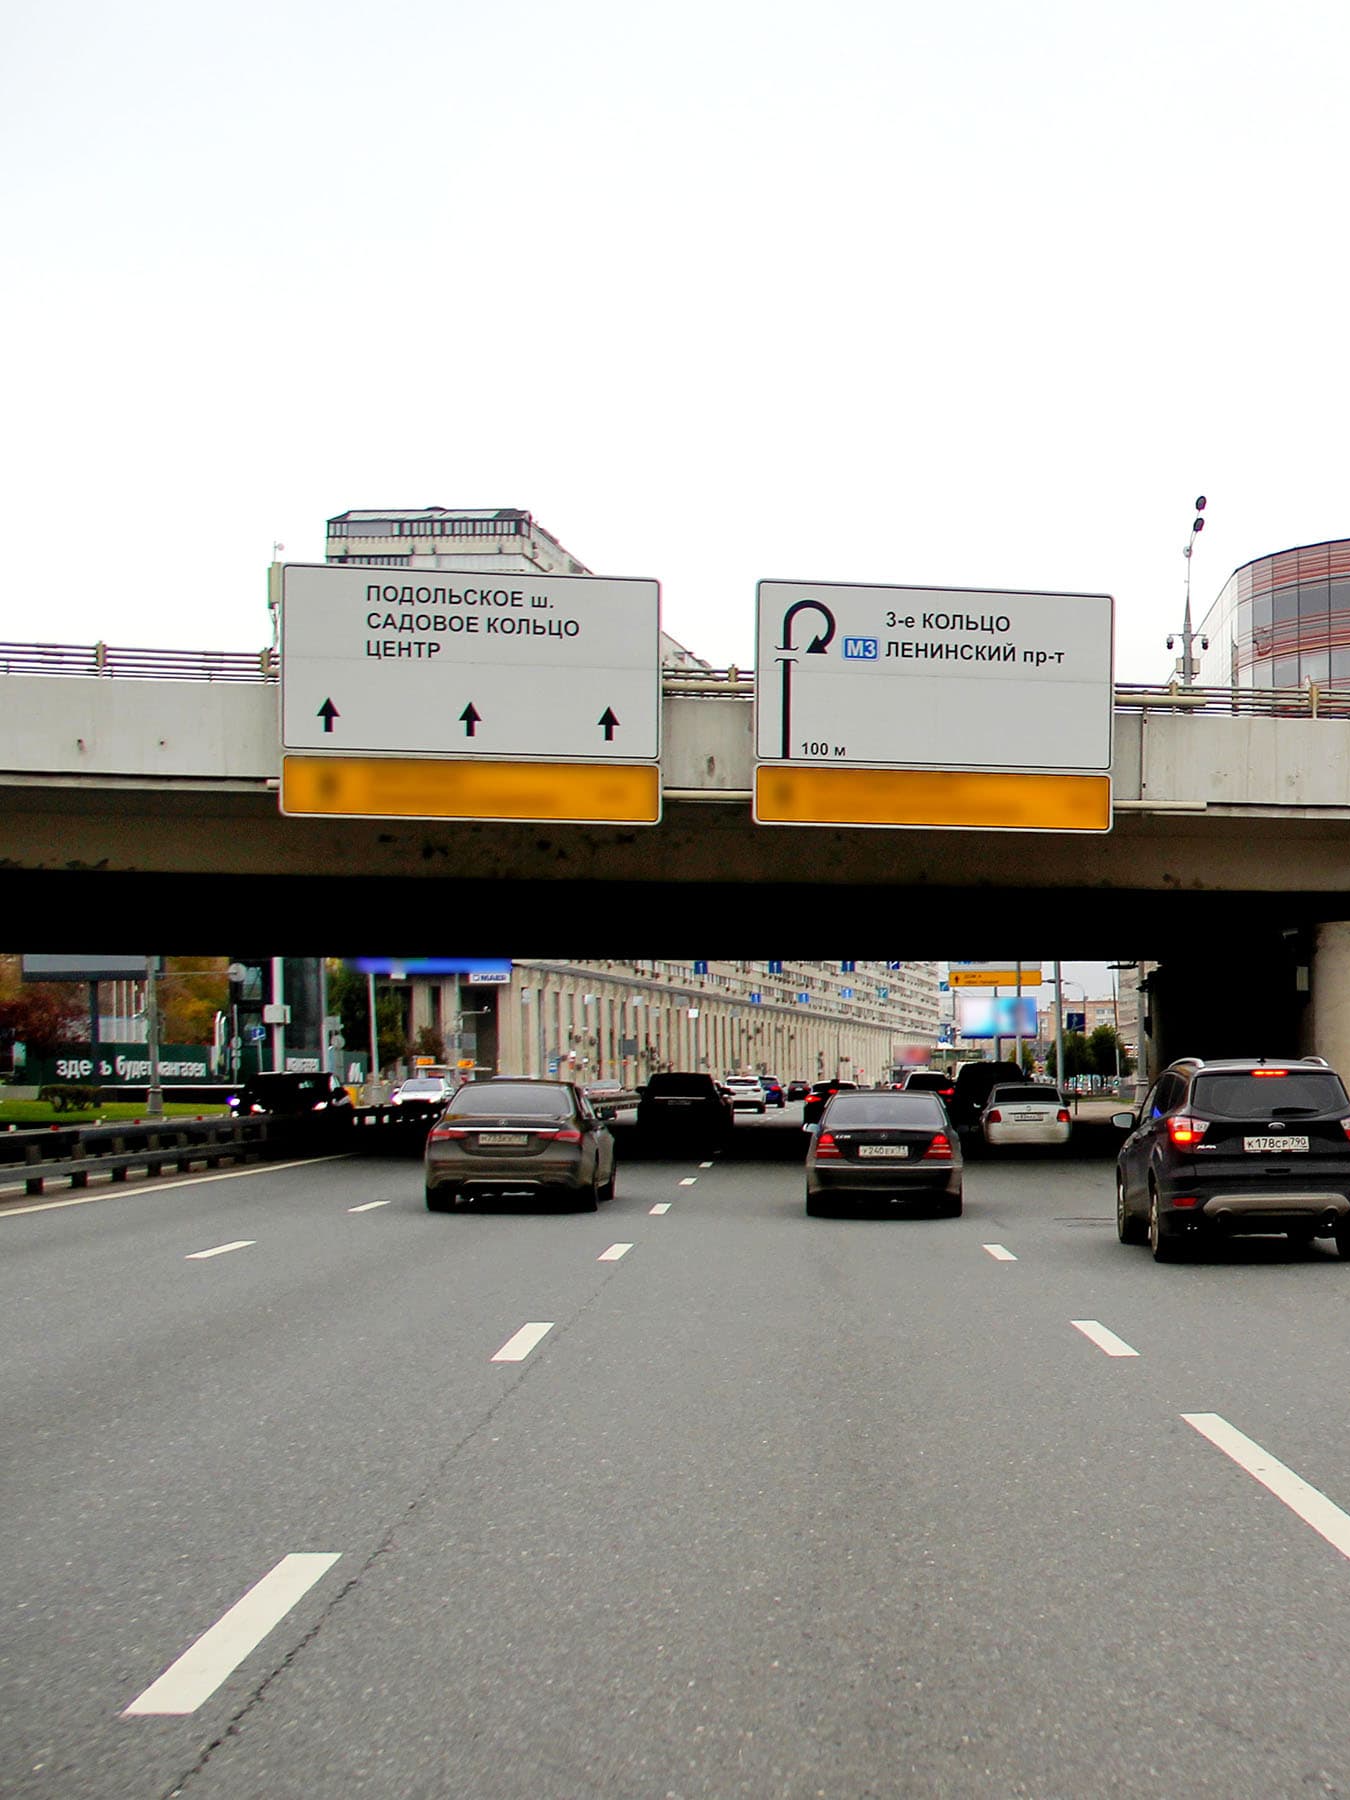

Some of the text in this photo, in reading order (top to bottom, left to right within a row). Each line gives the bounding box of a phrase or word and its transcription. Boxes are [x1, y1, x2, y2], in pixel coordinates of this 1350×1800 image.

[366, 584, 554, 609] ПОДОЛЬСКОЕ ш.
[367, 612, 580, 640] САДОВОЕ КОЛЬЦО
[886, 611, 1011, 635] 3-е КОЛЬЦО
[366, 639, 441, 660] ЦЕНТР
[885, 641, 1065, 667] ЛЕНИНСКИЙ пр-т
[801, 742, 846, 757] 100 м
[56, 1059, 113, 1079] здеь
[114, 1055, 153, 1081] будет
